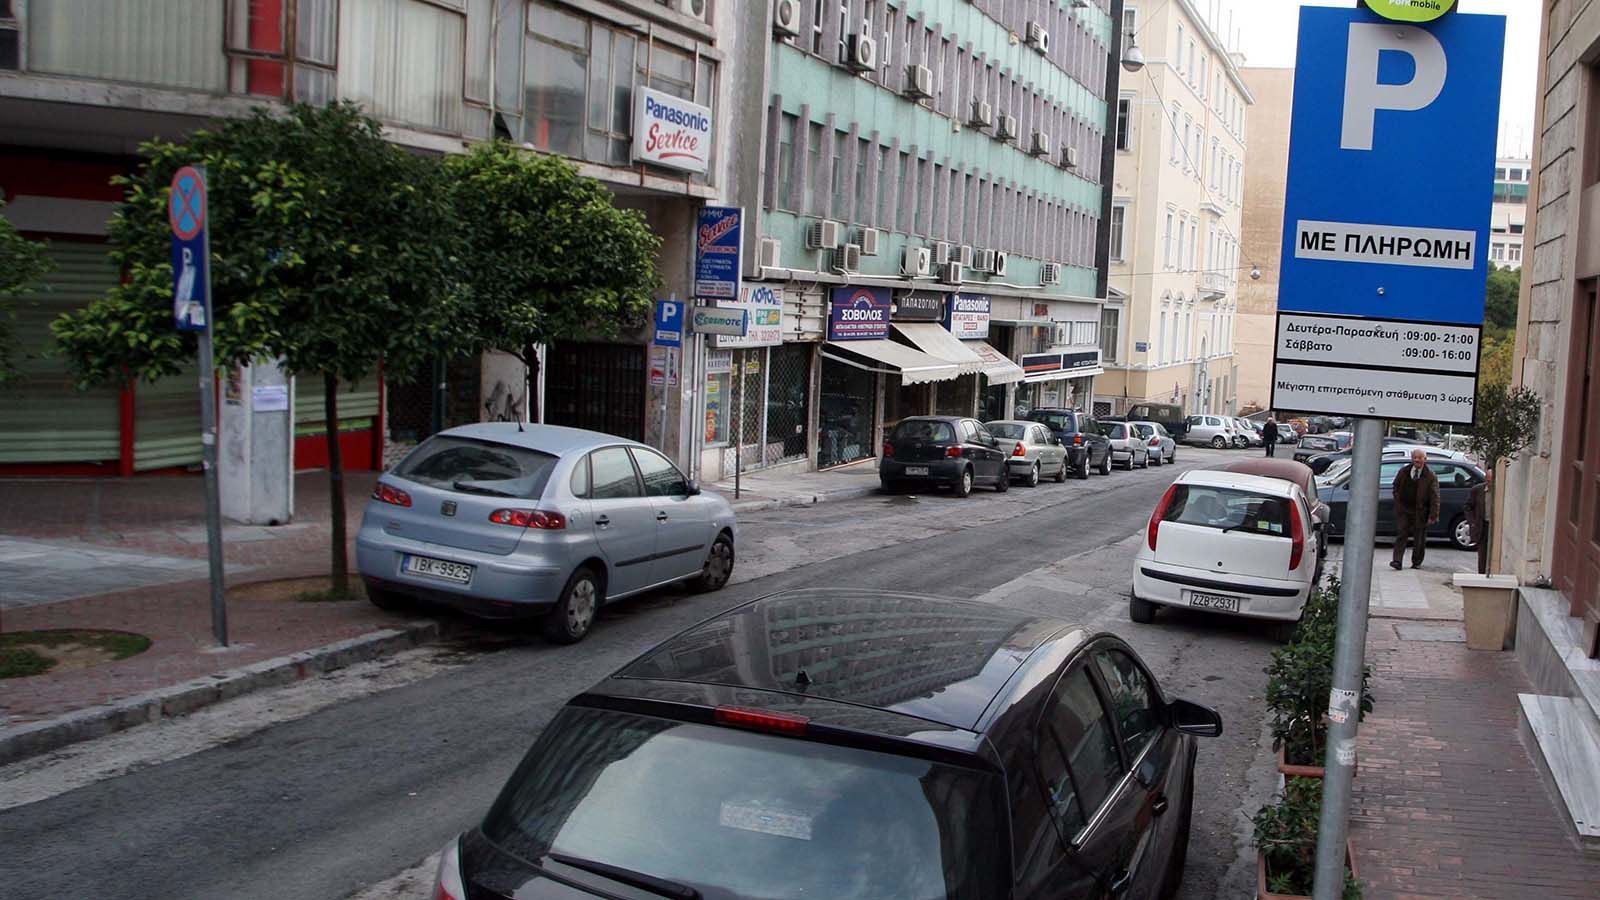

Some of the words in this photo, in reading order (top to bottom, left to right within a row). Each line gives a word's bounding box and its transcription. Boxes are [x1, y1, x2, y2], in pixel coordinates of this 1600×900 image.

[1340, 22, 1448, 151] P
[646, 96, 708, 132] Panasonic
[646, 122, 698, 152] Service
[1301, 231, 1337, 251] ΜΕ
[1344, 233, 1471, 260] ΠΛΗΡΩΜΗ
[662, 302, 677, 322] P
[901, 297, 939, 310] ΠΑΠΑΖΟΓΛΟΥ
[953, 295, 989, 312] Panasonic
[841, 309, 882, 321] ΣΟΒΟΛΟΣ
[1286, 322, 1399, 341] Δευτέρα-Παρασκευή
[1285, 339, 1332, 352] Σάββατο
[1277, 381, 1315, 393] Μέγιστη
[1317, 385, 1383, 399] επιτρεπόμενη
[1386, 390, 1438, 402] στάθμευση
[1440, 393, 1446, 401] 3
[1448, 393, 1473, 405] ώρες
